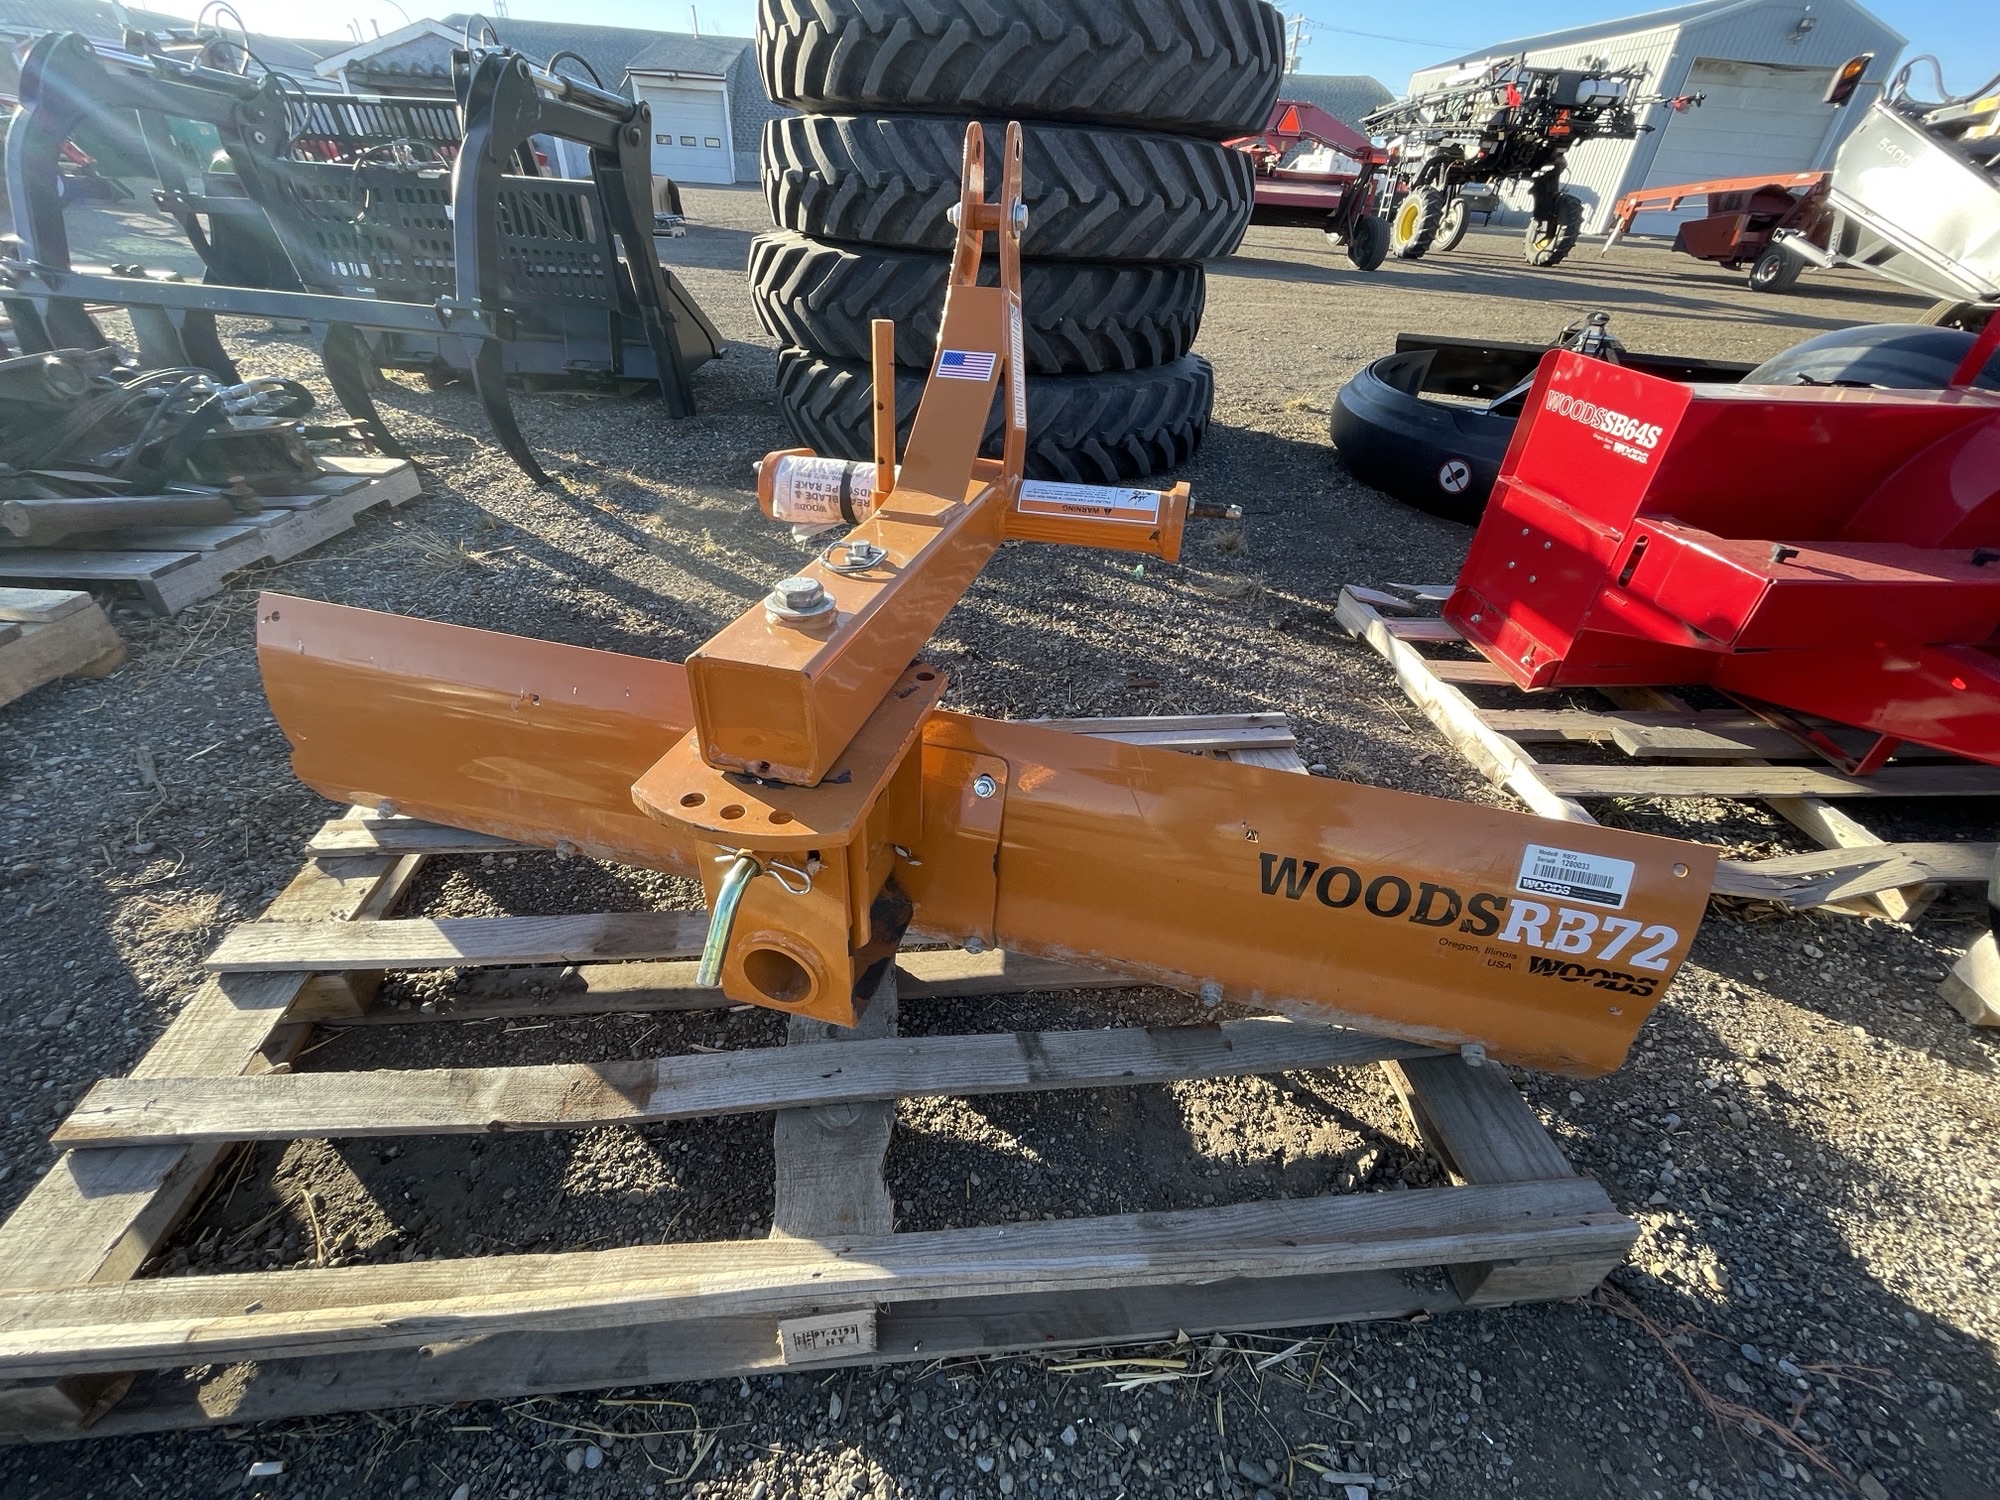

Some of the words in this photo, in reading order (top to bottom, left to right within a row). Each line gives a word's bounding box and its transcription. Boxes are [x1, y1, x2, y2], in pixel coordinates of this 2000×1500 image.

[1877, 137, 1912, 167] 5400
[1546, 390, 1608, 429] WOODS
[1601, 411, 1663, 449] SB64S
[794, 480, 821, 491] RAKE
[805, 491, 839, 504] BLADE
[850, 499, 870, 508] REA
[794, 502, 827, 513] WOODS
[1062, 504, 1100, 515] WARNING
[1563, 853, 1578, 861] RB72
[1562, 859, 1590, 870] 1280033
[1522, 878, 1571, 895] WOODS
[1259, 852, 1508, 936] WOODS
[1497, 899, 1679, 971] RB72
[1438, 937, 1481, 953] Oregon,
[1484, 947, 1518, 960] Illinois
[1486, 959, 1512, 970] USA
[1529, 955, 1659, 997] WOODS
